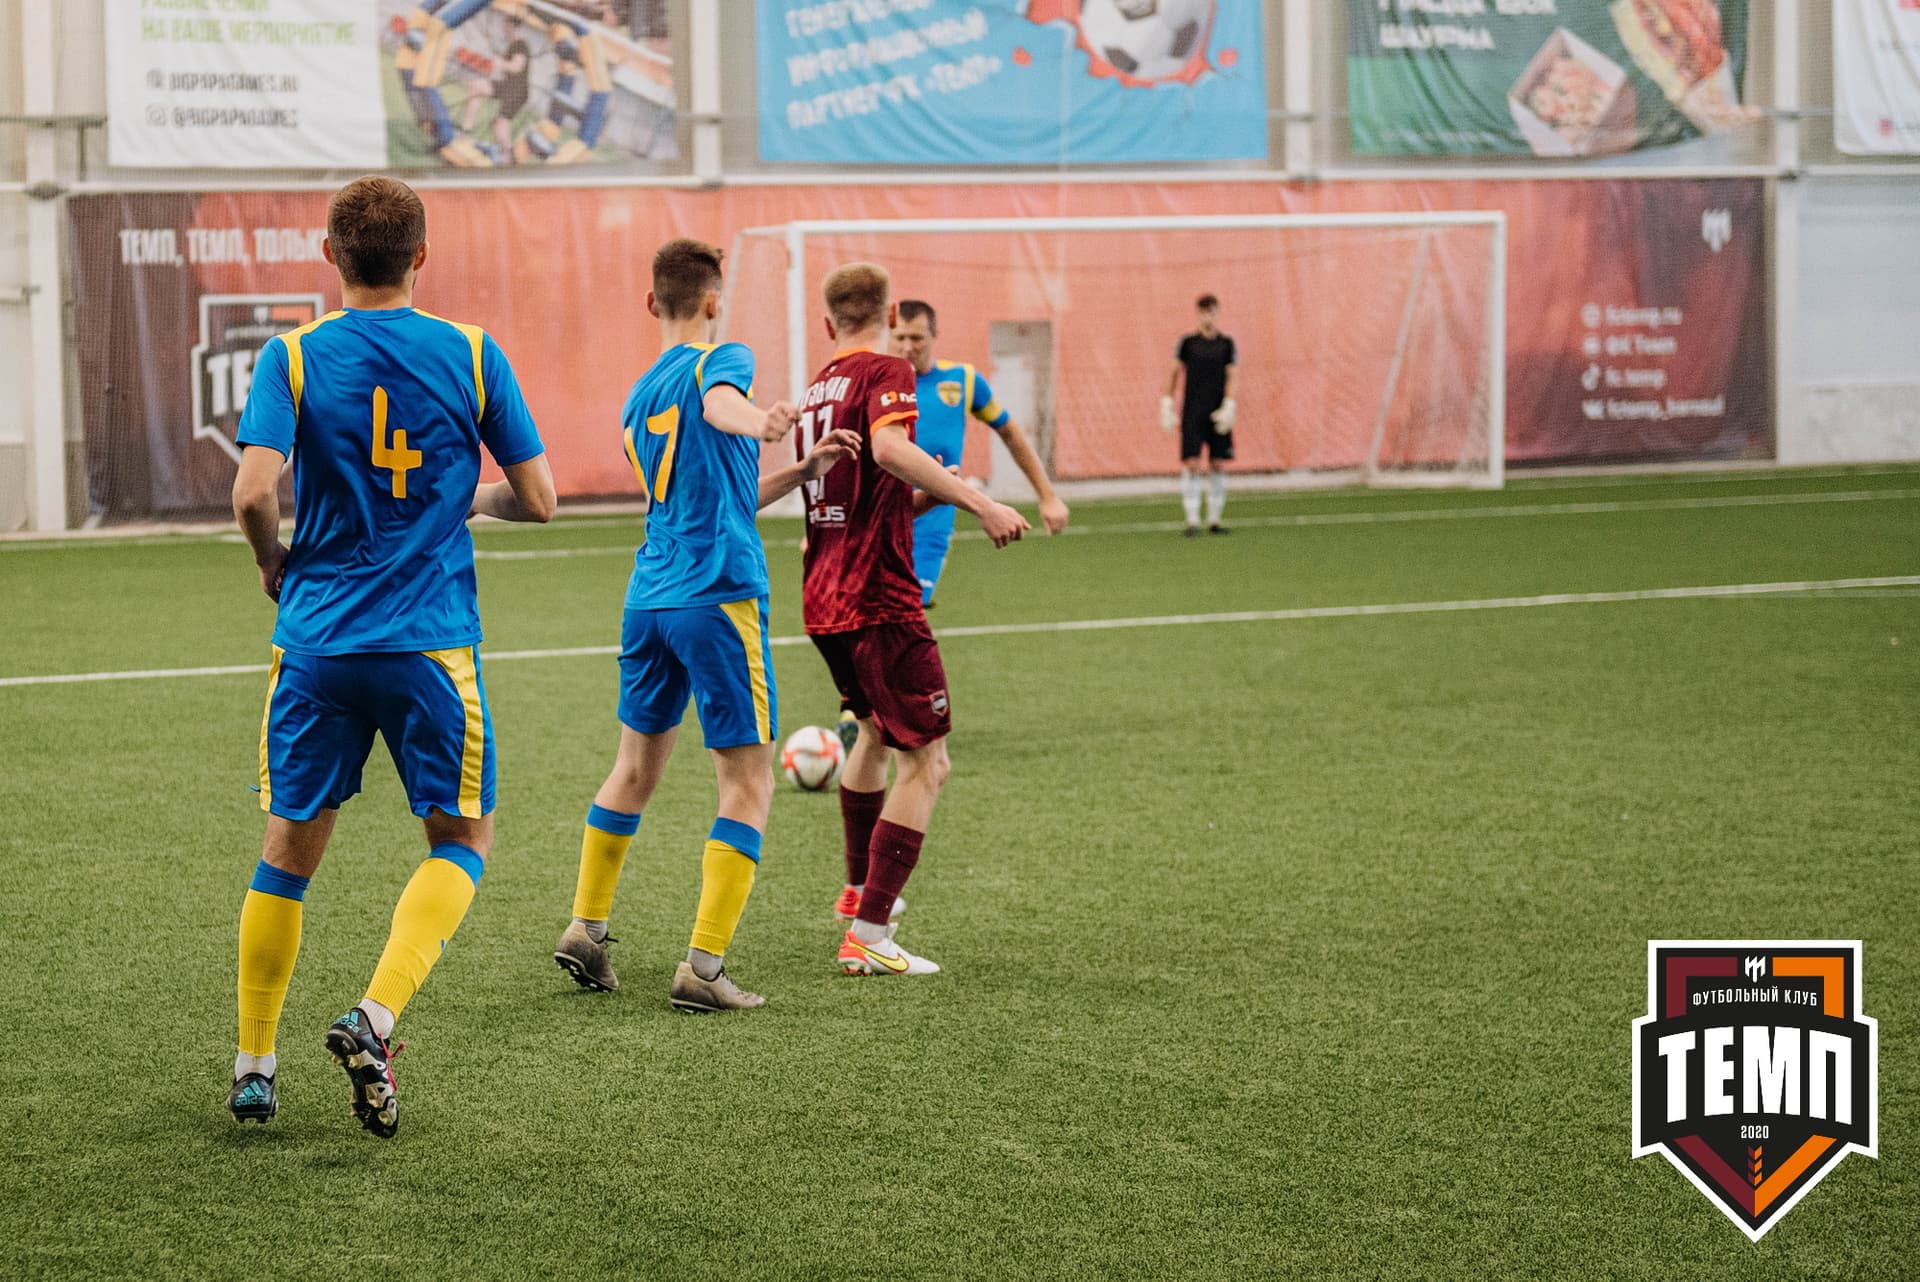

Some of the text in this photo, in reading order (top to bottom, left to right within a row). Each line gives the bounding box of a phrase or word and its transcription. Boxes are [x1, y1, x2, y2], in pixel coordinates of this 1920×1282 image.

[119, 227, 329, 268] ТЕМП, ТЕМП, ТОЛЬК
[372, 385, 422, 498] 4
